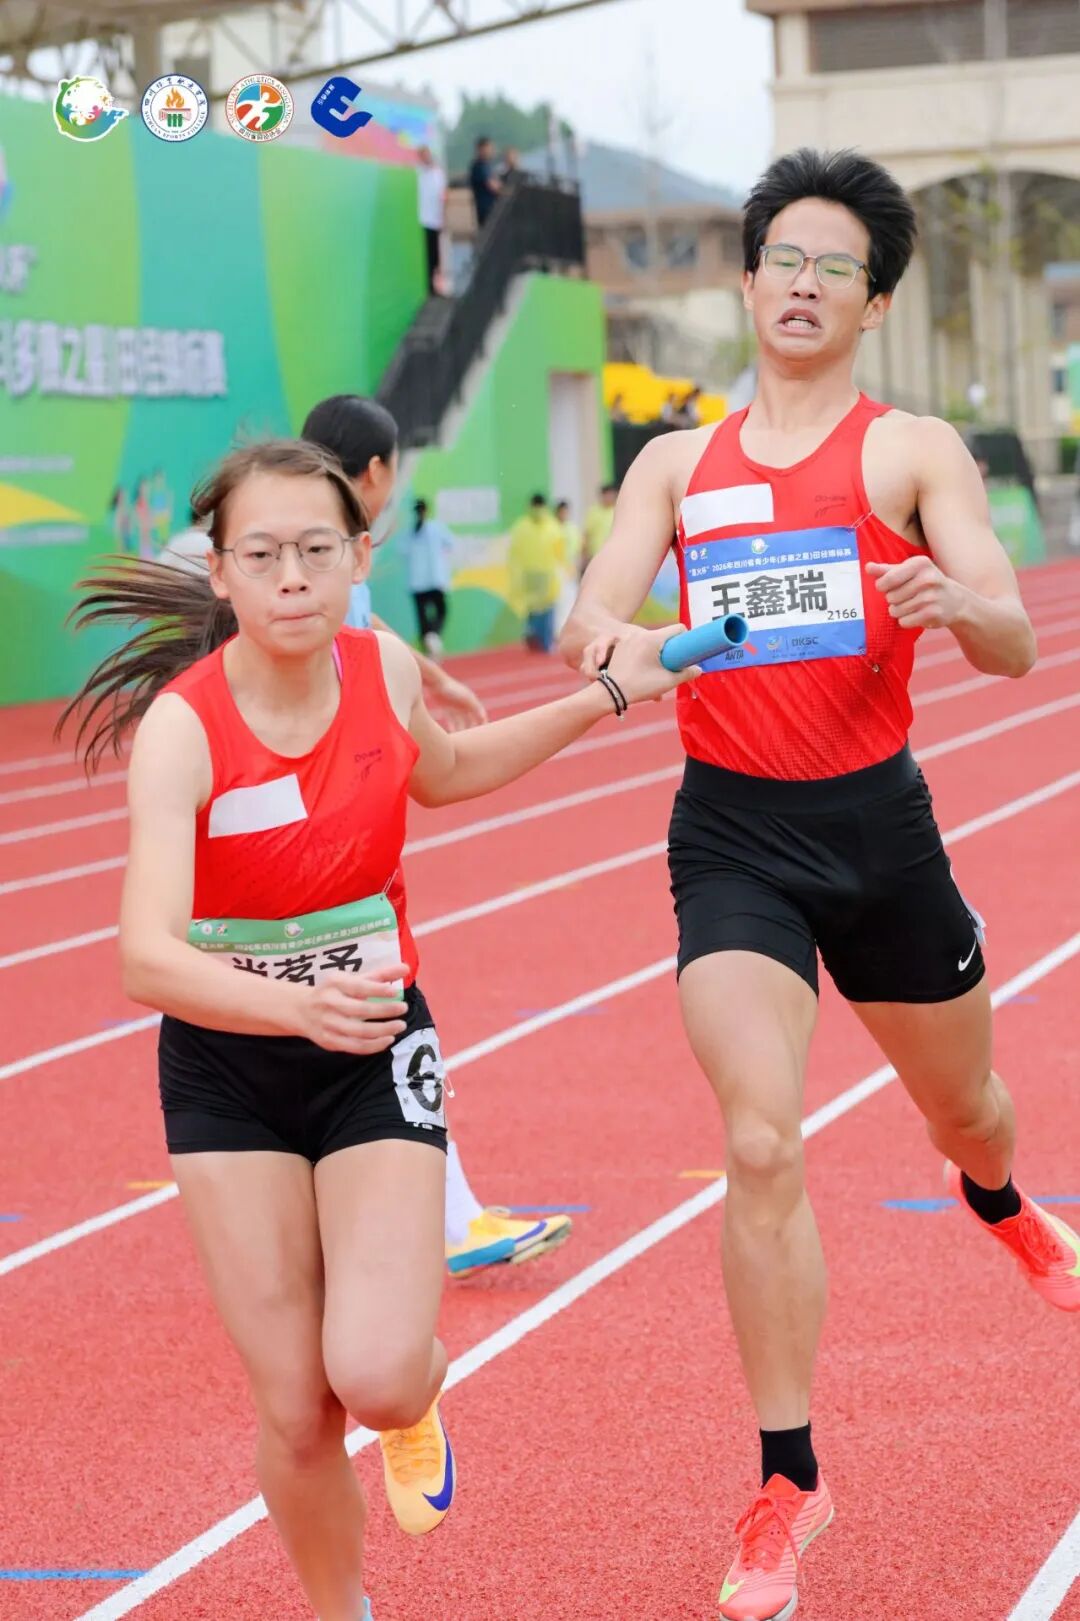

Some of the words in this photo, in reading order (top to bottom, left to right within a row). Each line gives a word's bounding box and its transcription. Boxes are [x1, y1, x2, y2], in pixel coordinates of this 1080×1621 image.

[711, 569, 828, 621] 王鑫瑞
[827, 609, 858, 621] 2166
[725, 649, 745, 661] ANTA
[406, 1043, 443, 1113] 6
